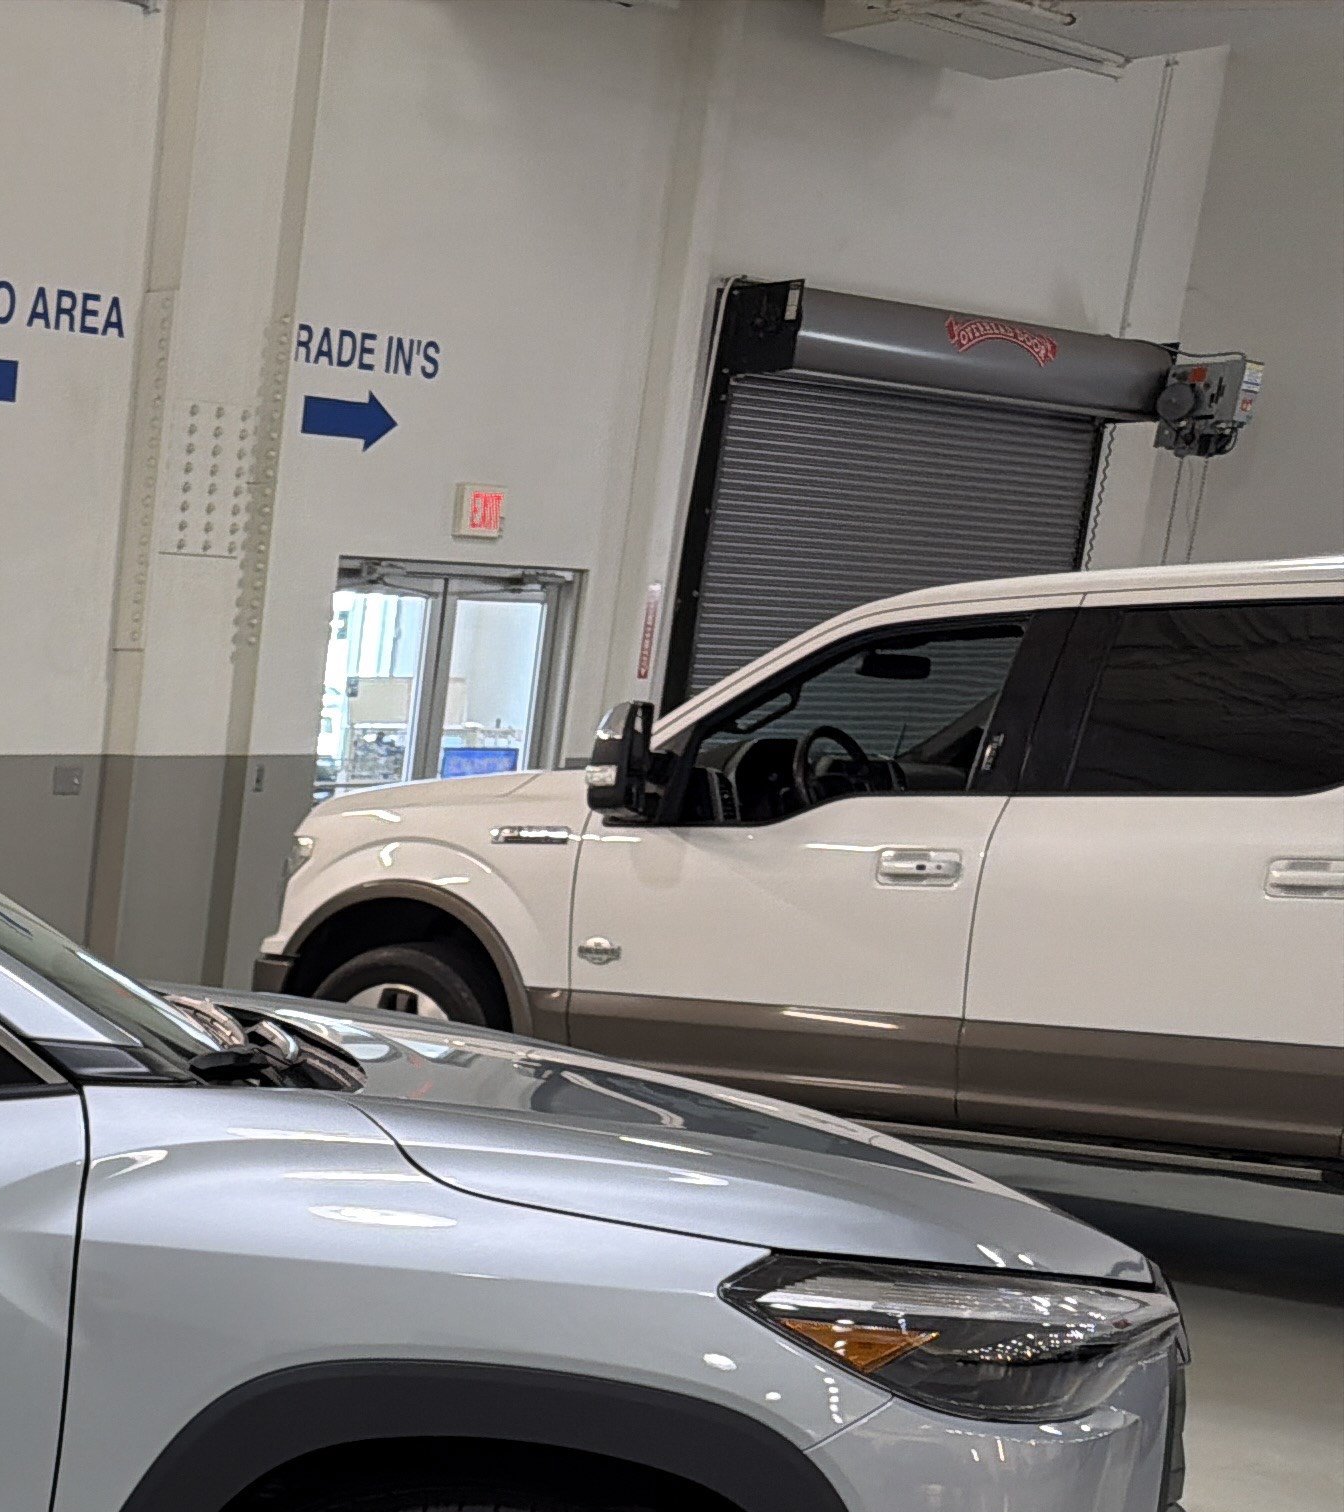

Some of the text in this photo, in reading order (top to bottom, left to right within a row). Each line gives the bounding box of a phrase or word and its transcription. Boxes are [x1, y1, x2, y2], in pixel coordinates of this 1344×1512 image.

[26, 286, 125, 339] AREA
[293, 323, 441, 380] RADE IN'S
[471, 491, 504, 530] EXIT
